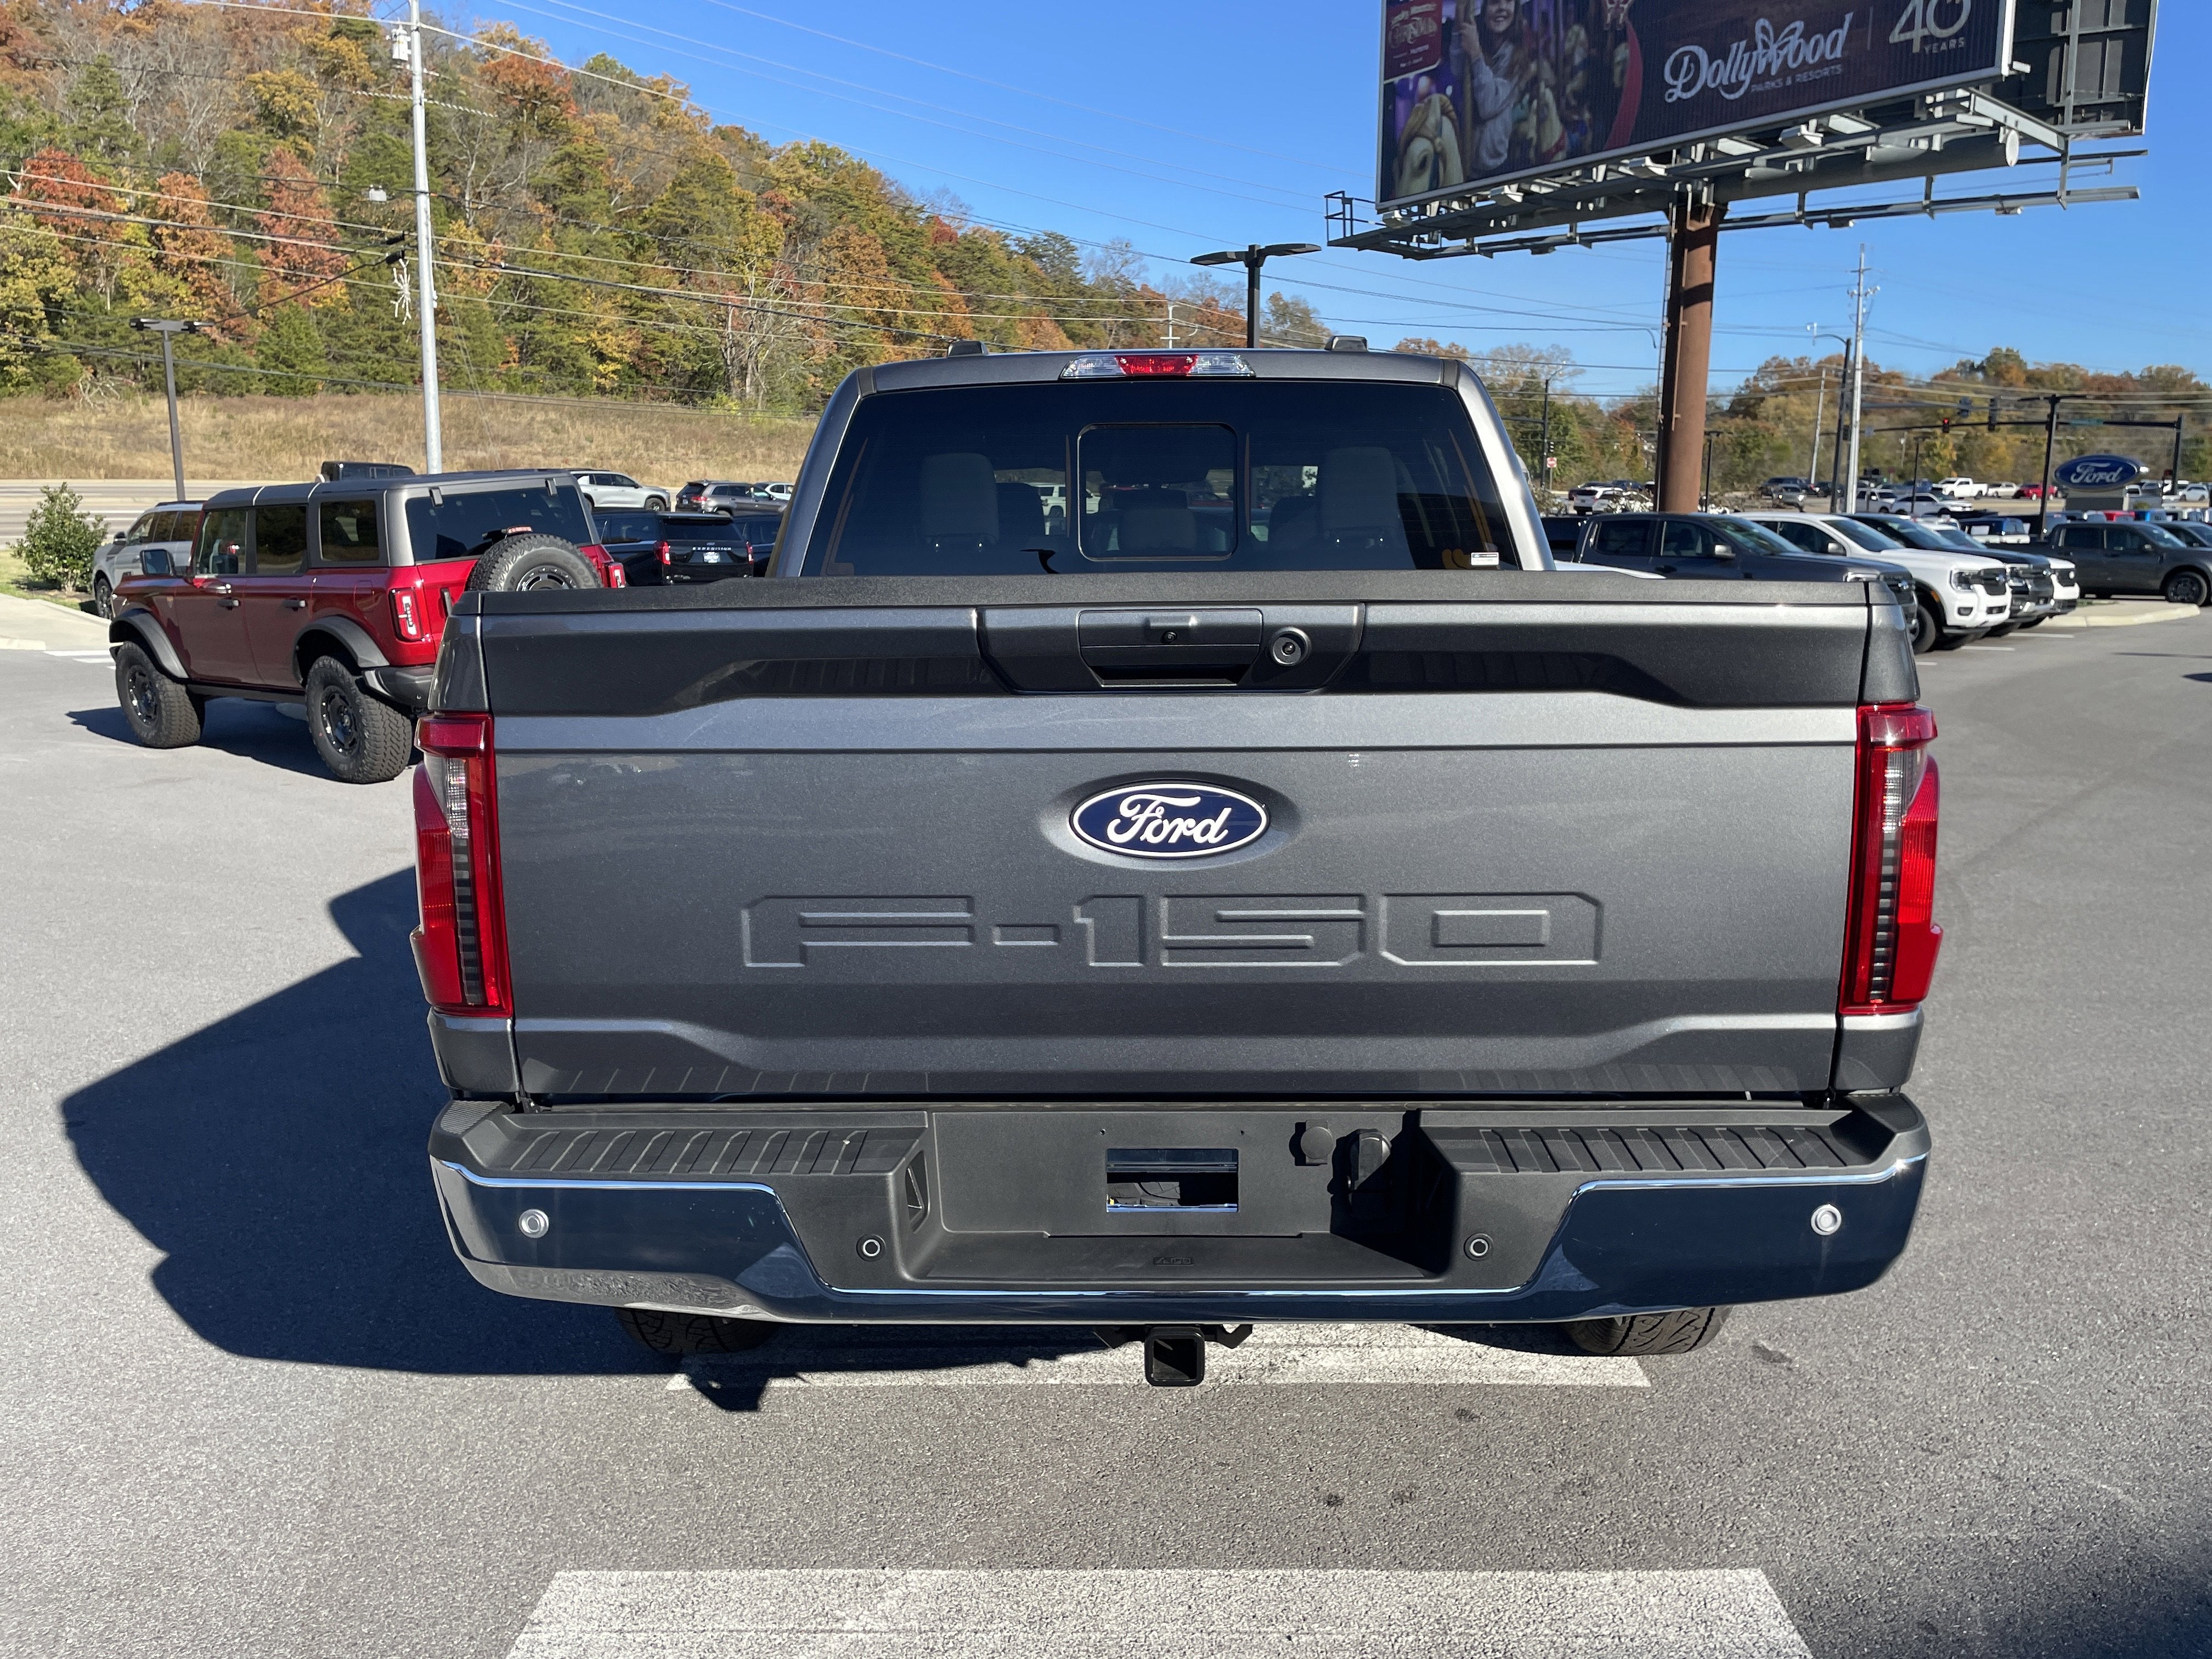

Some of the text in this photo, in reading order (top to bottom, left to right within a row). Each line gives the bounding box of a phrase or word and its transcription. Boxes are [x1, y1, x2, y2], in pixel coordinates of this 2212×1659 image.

[1889, 0, 1971, 53] 40
[1923, 37, 1966, 54] YEARS
[1751, 78, 1784, 93] PARKS
[1795, 64, 1842, 82] RESORTS
[2070, 462, 2123, 483] Ford
[1107, 794, 1232, 844] Ford
[741, 892, 1604, 968] F-150
